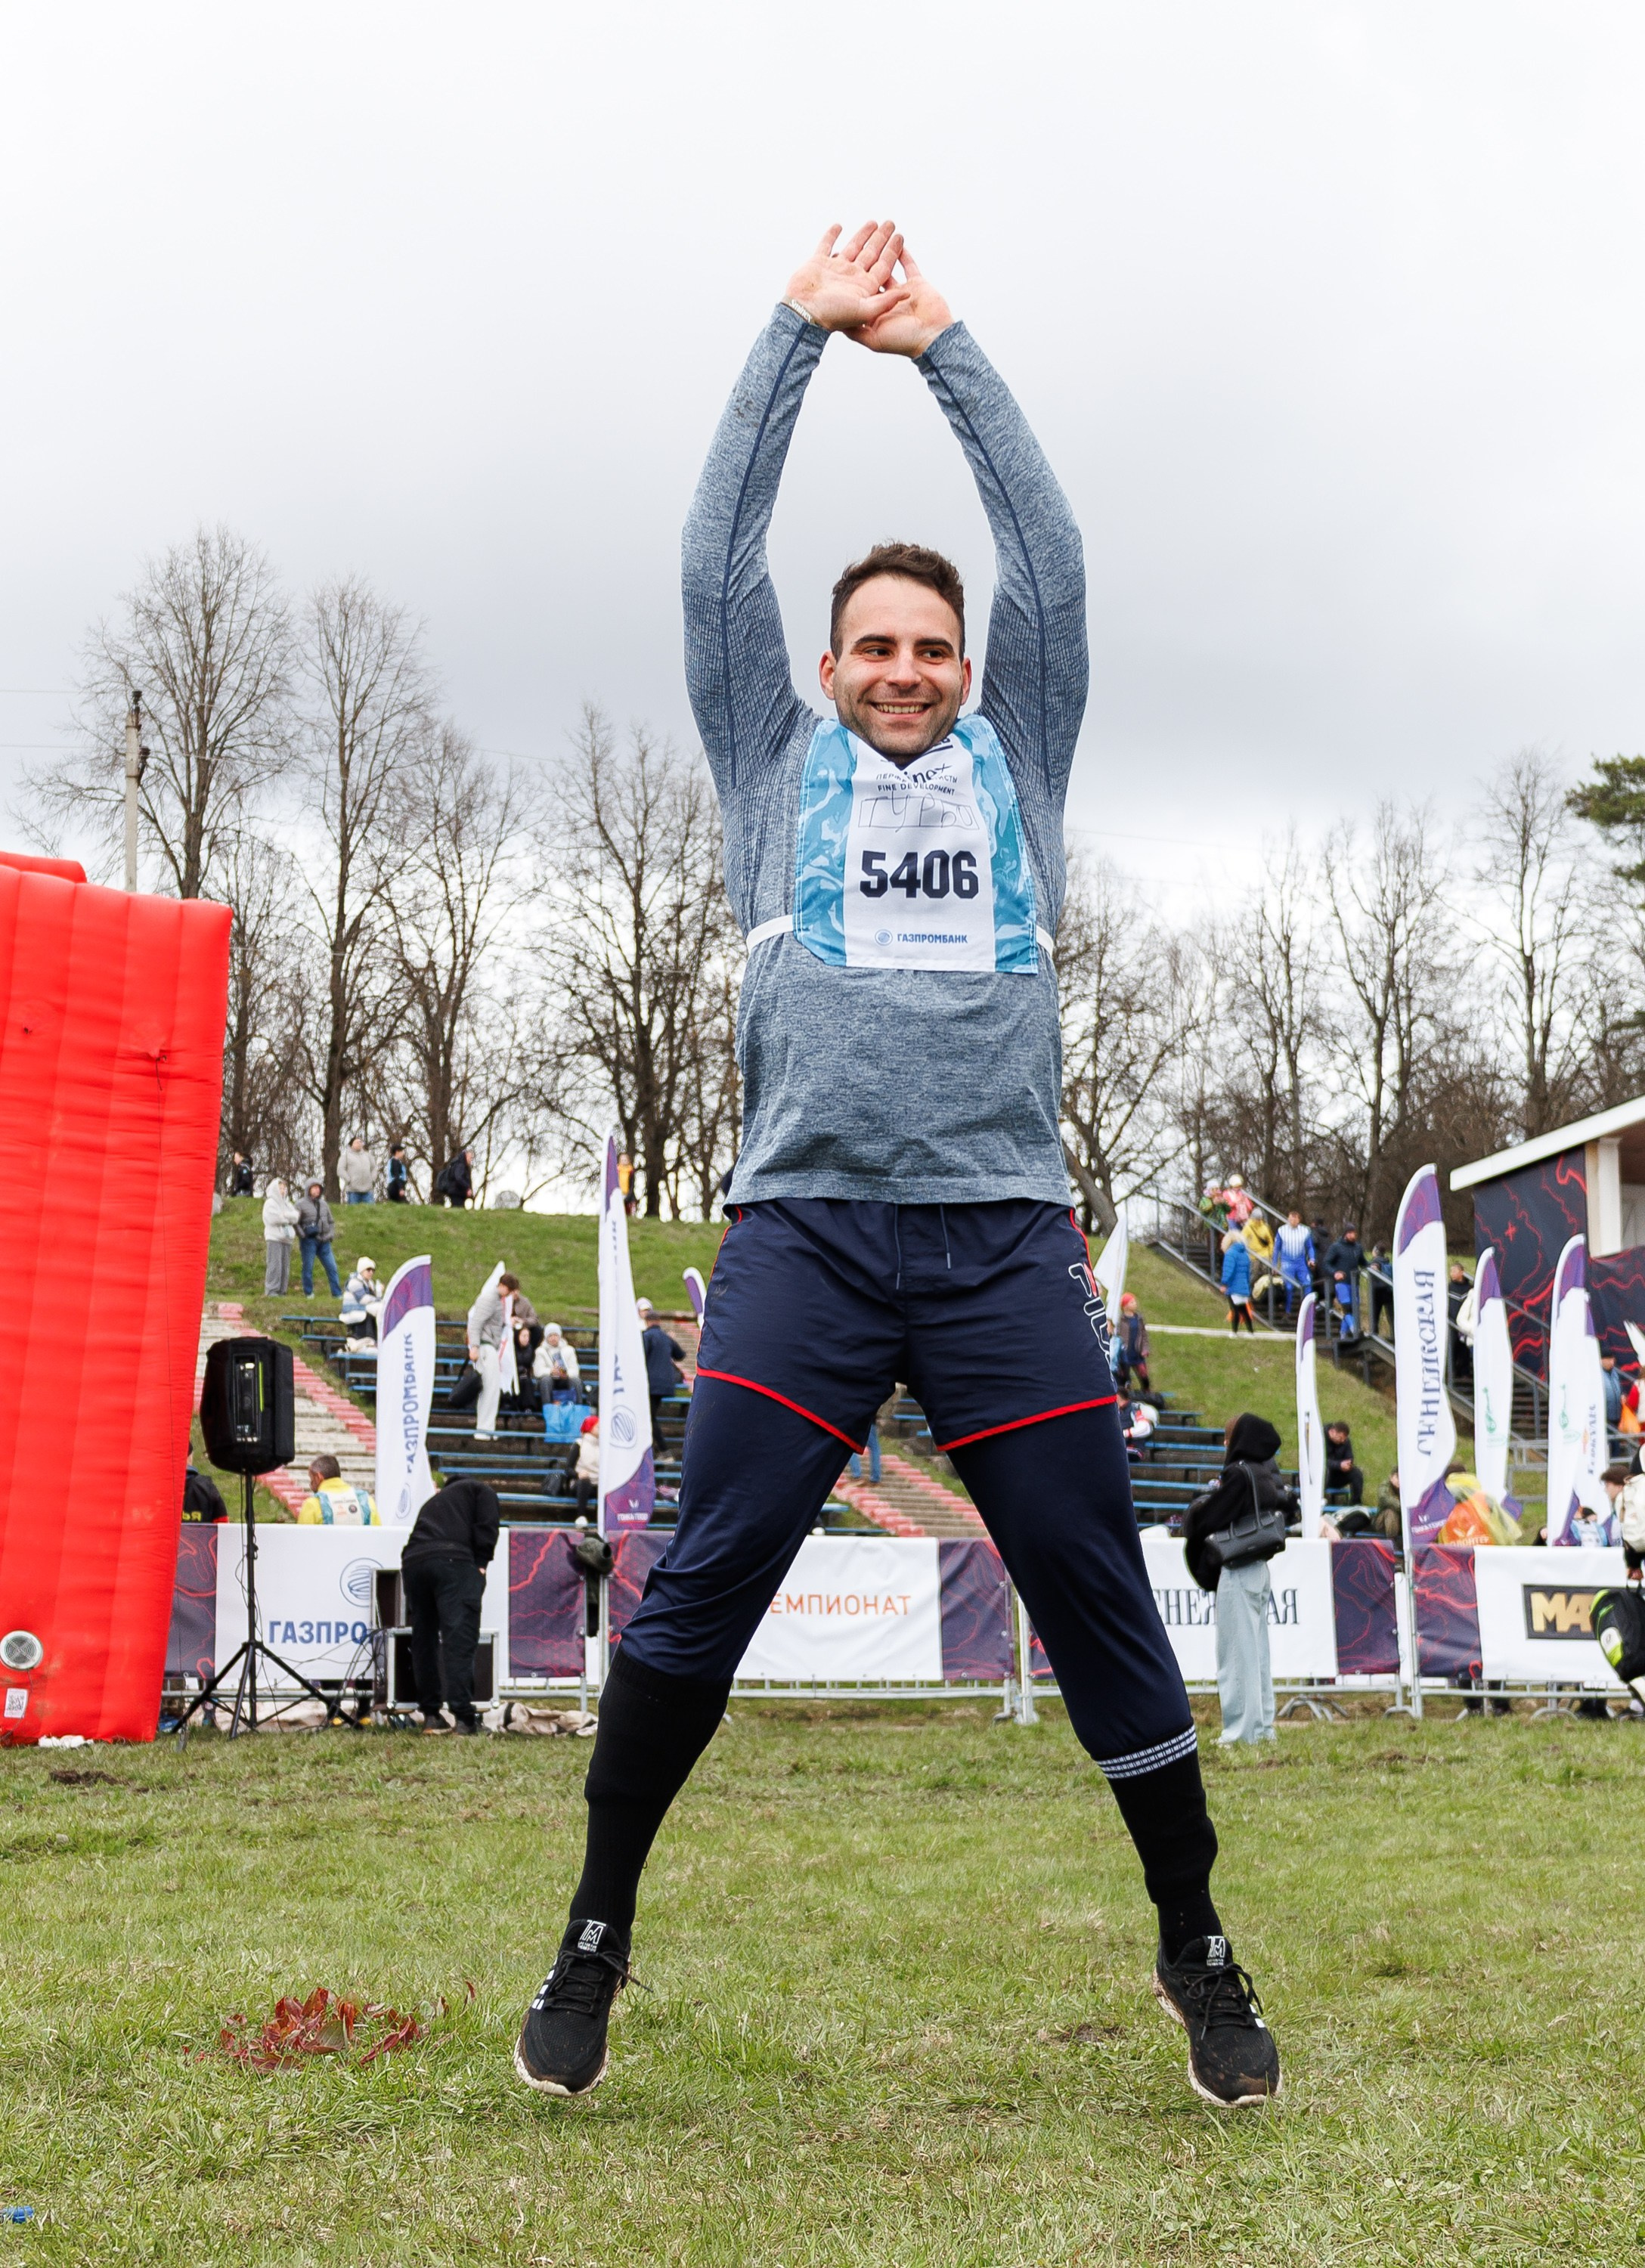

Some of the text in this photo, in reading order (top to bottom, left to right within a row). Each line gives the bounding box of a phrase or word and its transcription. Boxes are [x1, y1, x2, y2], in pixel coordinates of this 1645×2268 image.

[877, 782, 956, 797] FINE DEVELOPMENT
[860, 850, 979, 899] 5406
[897, 933, 968, 944] ГАЗПРОМБАНК
[1068, 1263, 1117, 1390] FIL
[401, 1331, 420, 1474] ГАЗПРОМБАНК
[770, 1593, 911, 1616] ЕМПИОНАТ
[268, 1620, 367, 1644] ГАЗПРО
